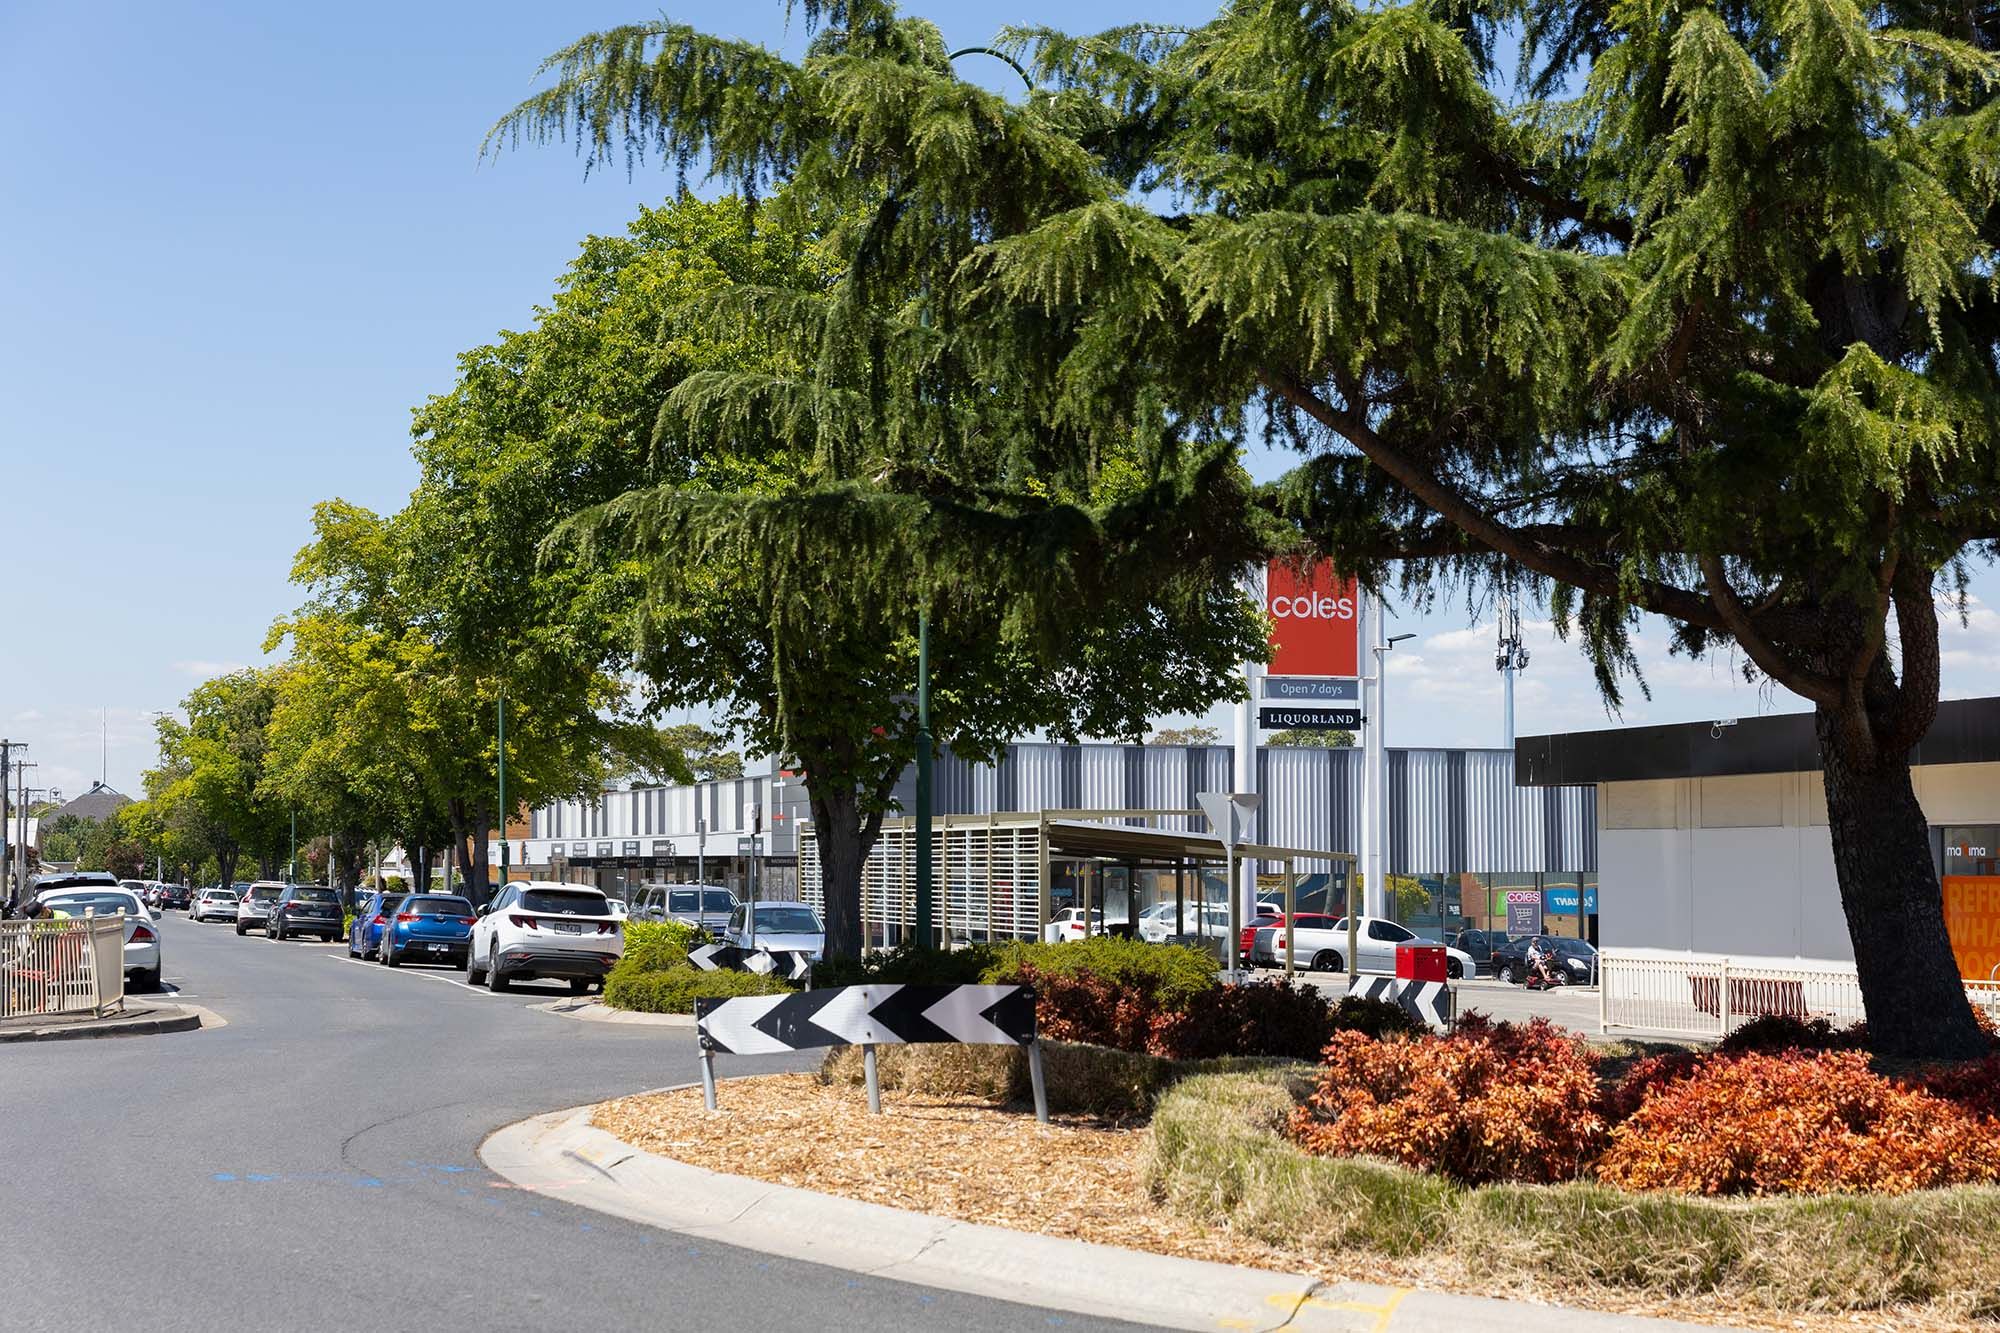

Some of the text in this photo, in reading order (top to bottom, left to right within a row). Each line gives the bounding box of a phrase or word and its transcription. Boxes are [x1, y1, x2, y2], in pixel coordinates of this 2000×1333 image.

[1271, 591, 1354, 620] coles
[1280, 683, 1343, 696] Open 7 days
[1270, 713, 1354, 726] LIQUORLAND
[1507, 892, 1540, 903] coles
